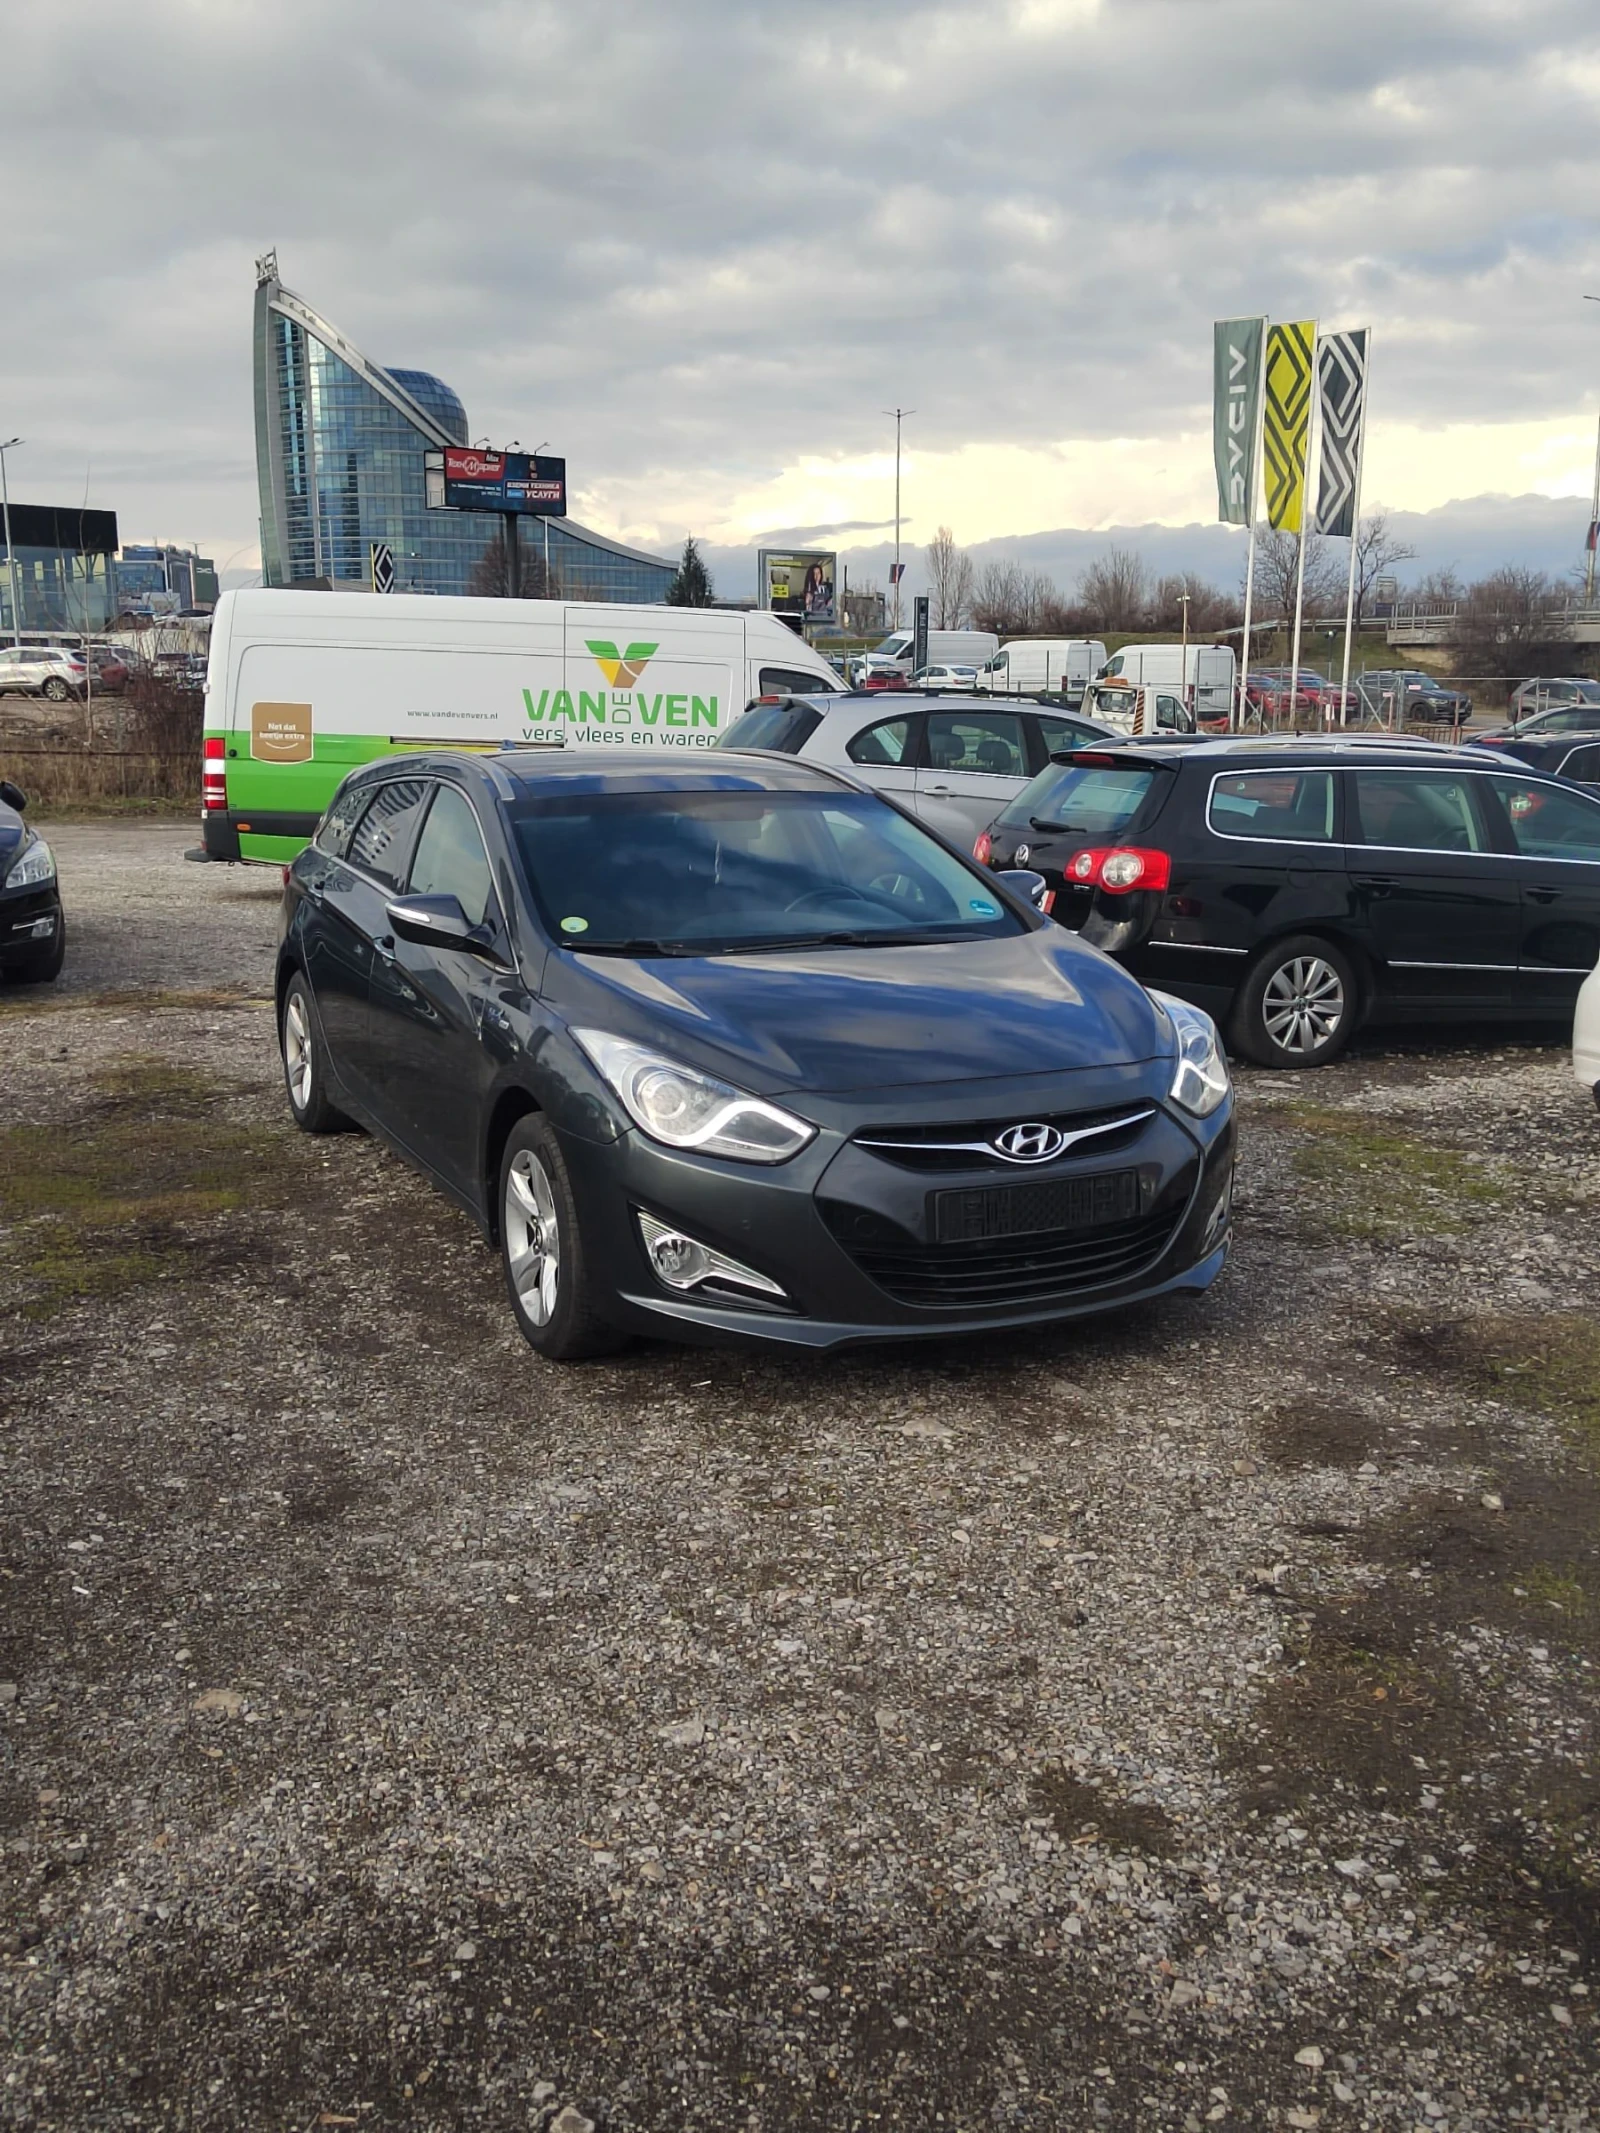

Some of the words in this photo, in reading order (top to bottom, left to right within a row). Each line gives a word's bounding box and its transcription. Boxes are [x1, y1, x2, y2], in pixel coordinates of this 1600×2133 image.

[526, 490, 560, 499] УСЛУГИ
[407, 710, 498, 720] www.vandevenvers.nl
[522, 688, 606, 724] VAN
[612, 692, 631, 724] DE
[636, 693, 718, 727] VEN
[522, 728, 569, 745] vers,
[575, 726, 625, 744] vlees
[631, 730, 654, 746] en
